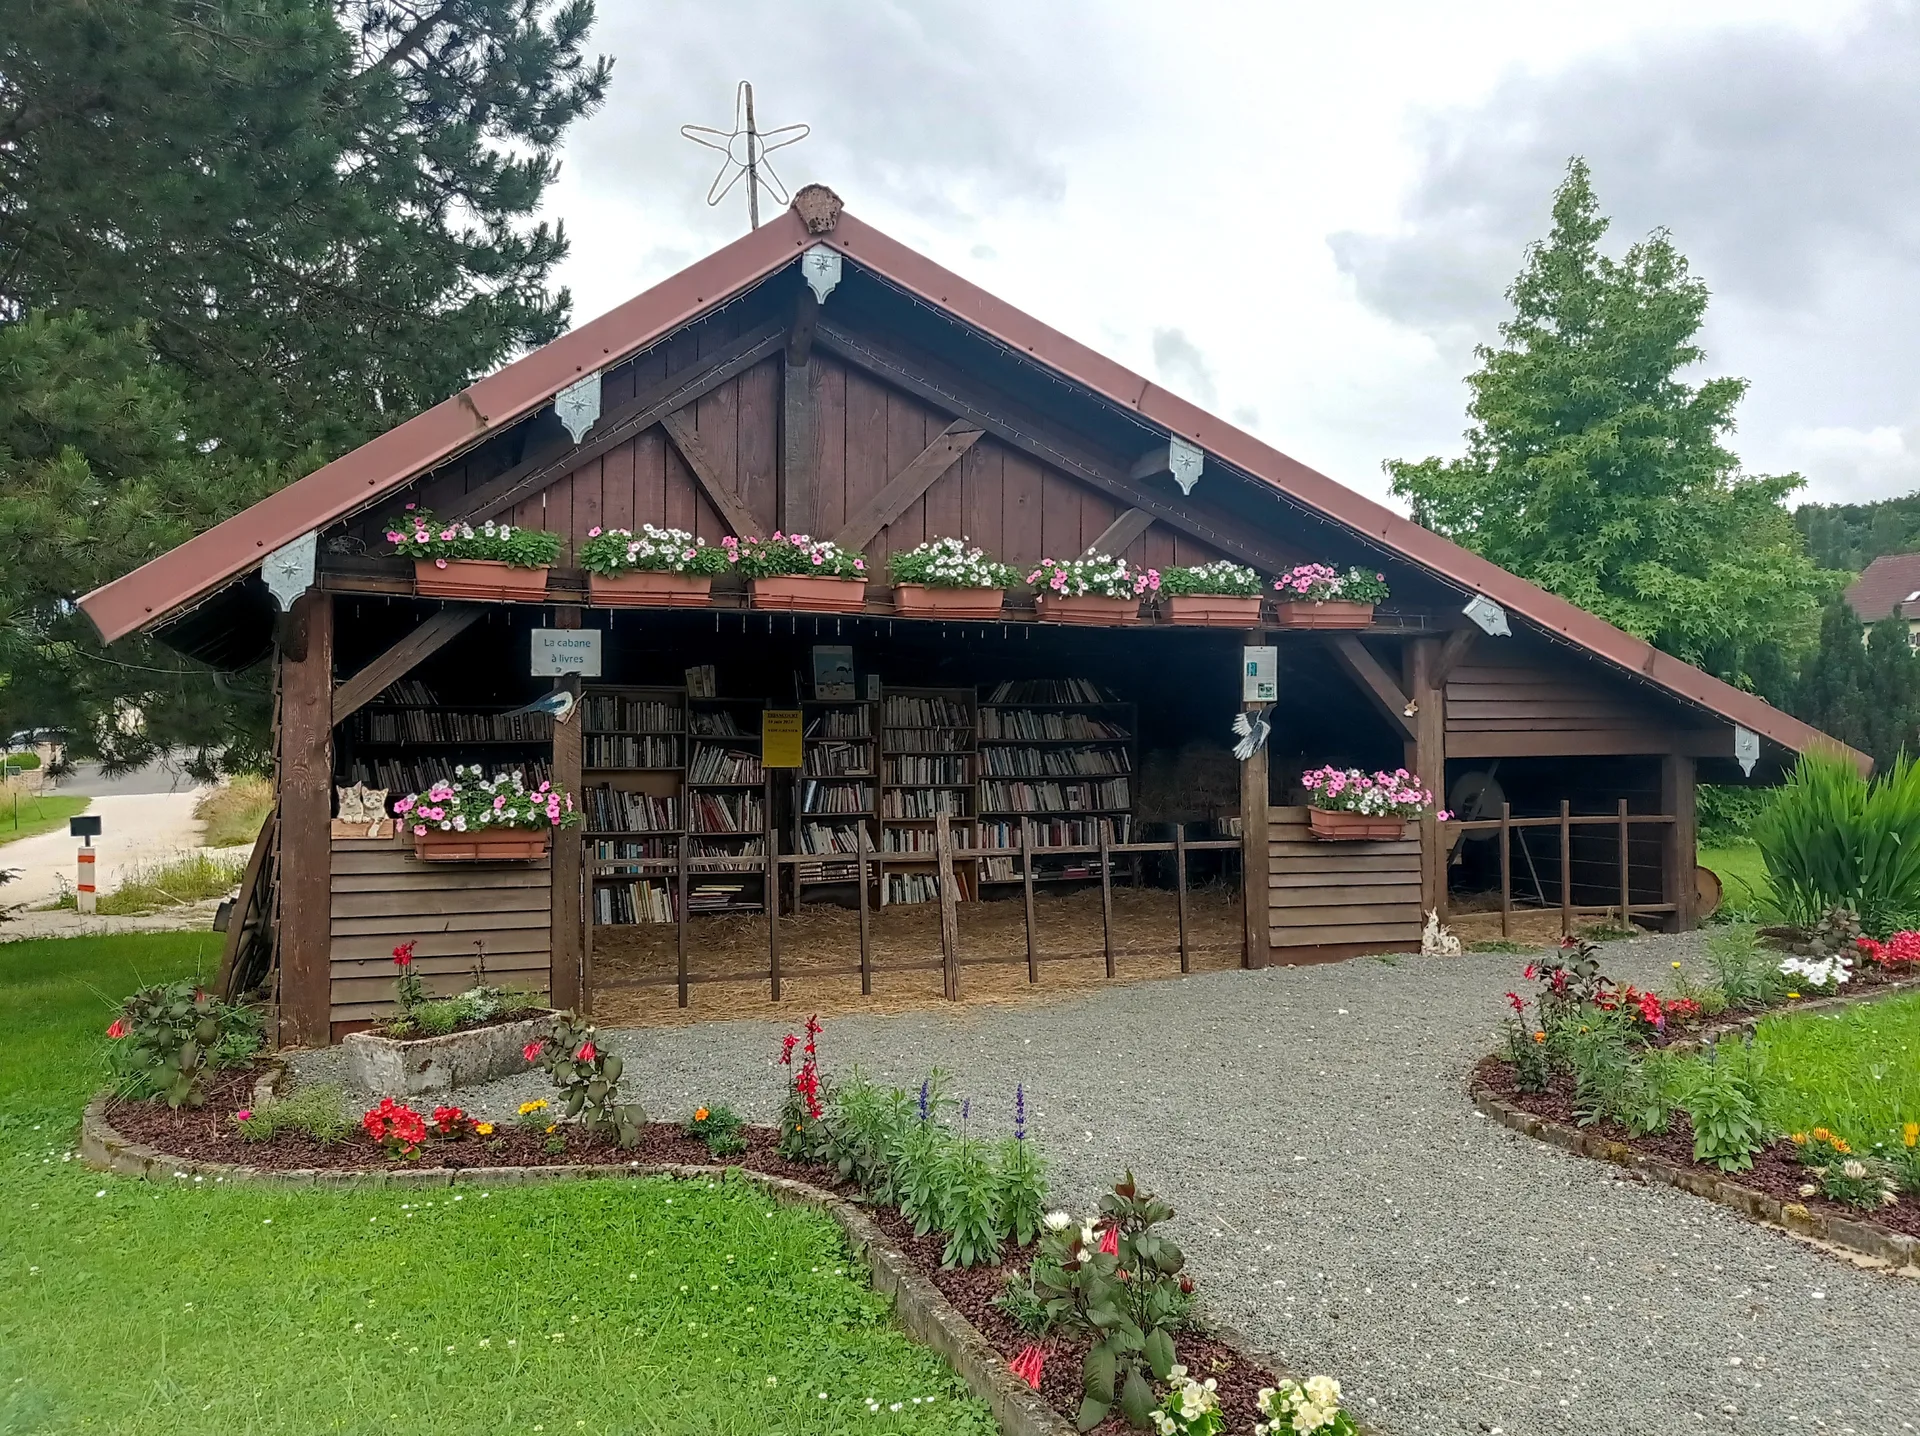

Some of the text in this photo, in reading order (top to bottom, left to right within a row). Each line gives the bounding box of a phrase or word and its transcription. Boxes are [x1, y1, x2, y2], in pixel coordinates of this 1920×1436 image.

[544, 638, 591, 648] La cabane
[551, 653, 584, 663] à livres
